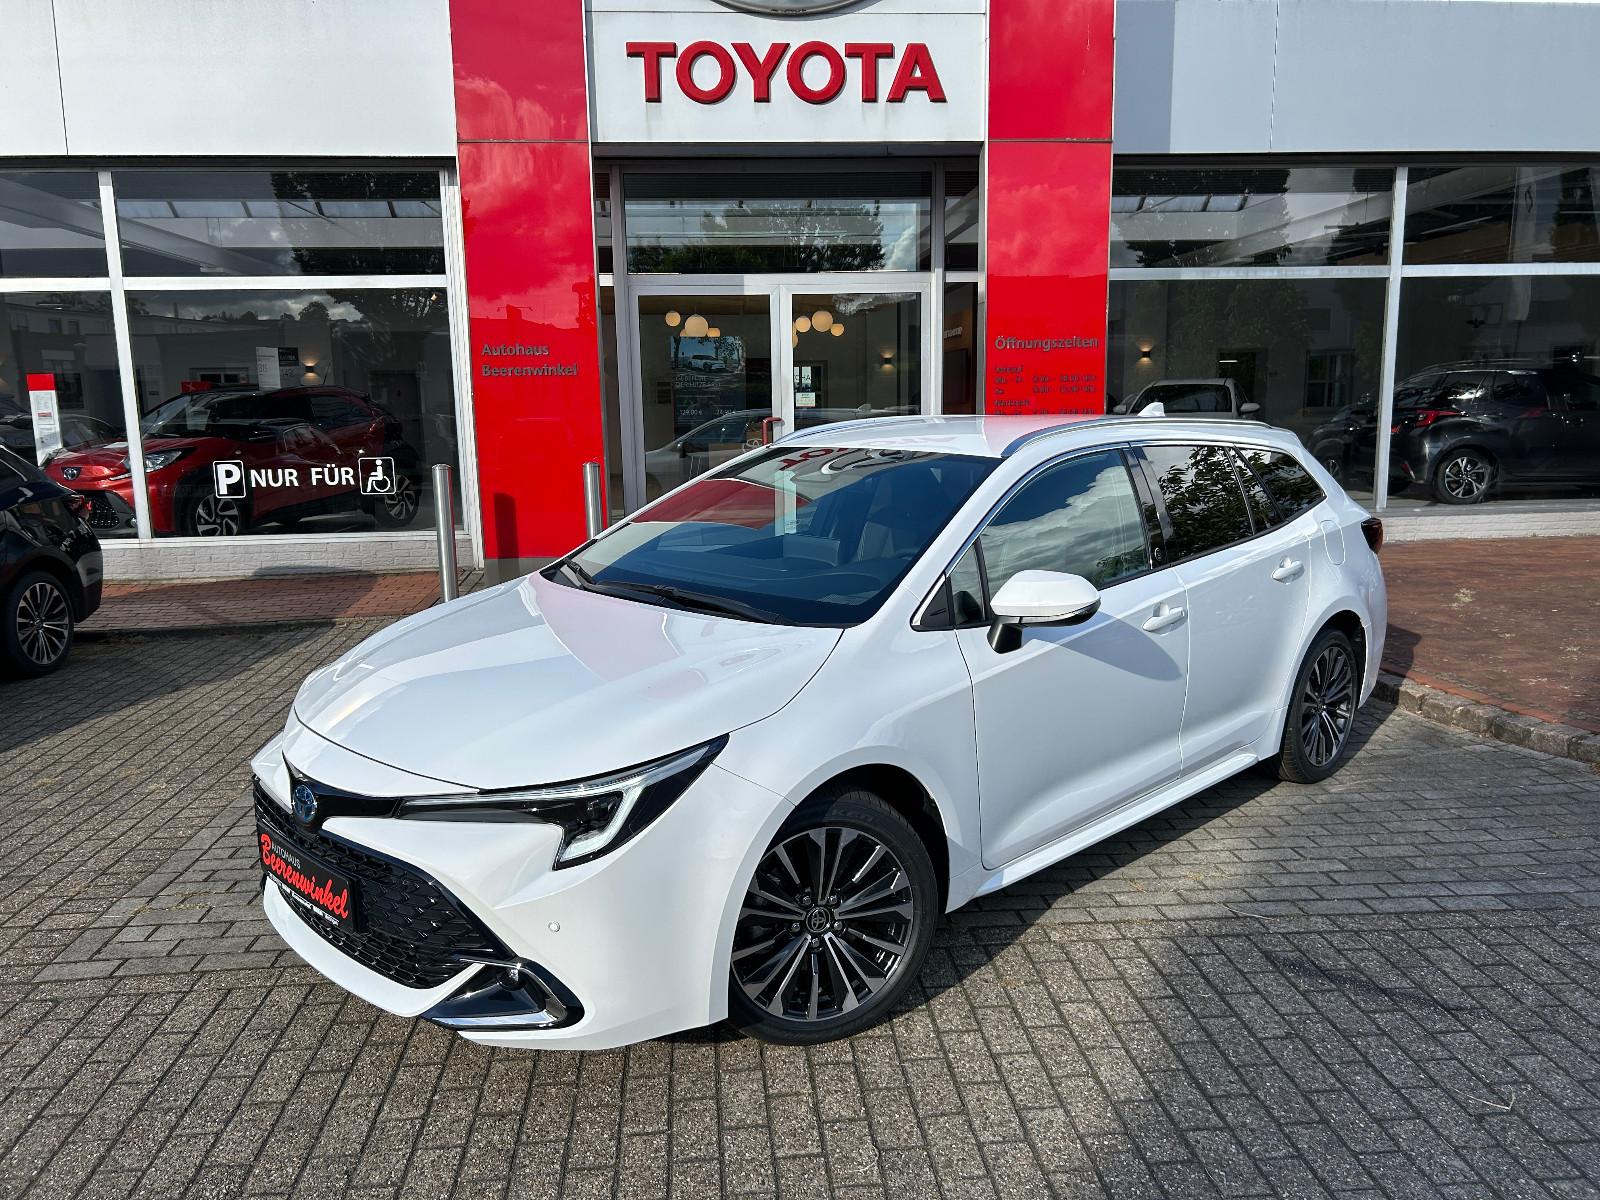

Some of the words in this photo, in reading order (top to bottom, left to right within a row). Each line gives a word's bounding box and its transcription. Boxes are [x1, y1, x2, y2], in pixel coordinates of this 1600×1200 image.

[626, 40, 948, 105] TOYOTA
[481, 342, 550, 356] Autohaus
[995, 335, 1099, 352] Öffnungszeiten
[482, 362, 578, 377] Beerenwinkel
[217, 463, 241, 495] P
[250, 468, 299, 488] NUR
[310, 463, 356, 486] FÜR
[260, 833, 348, 919] Beerenwinkel
